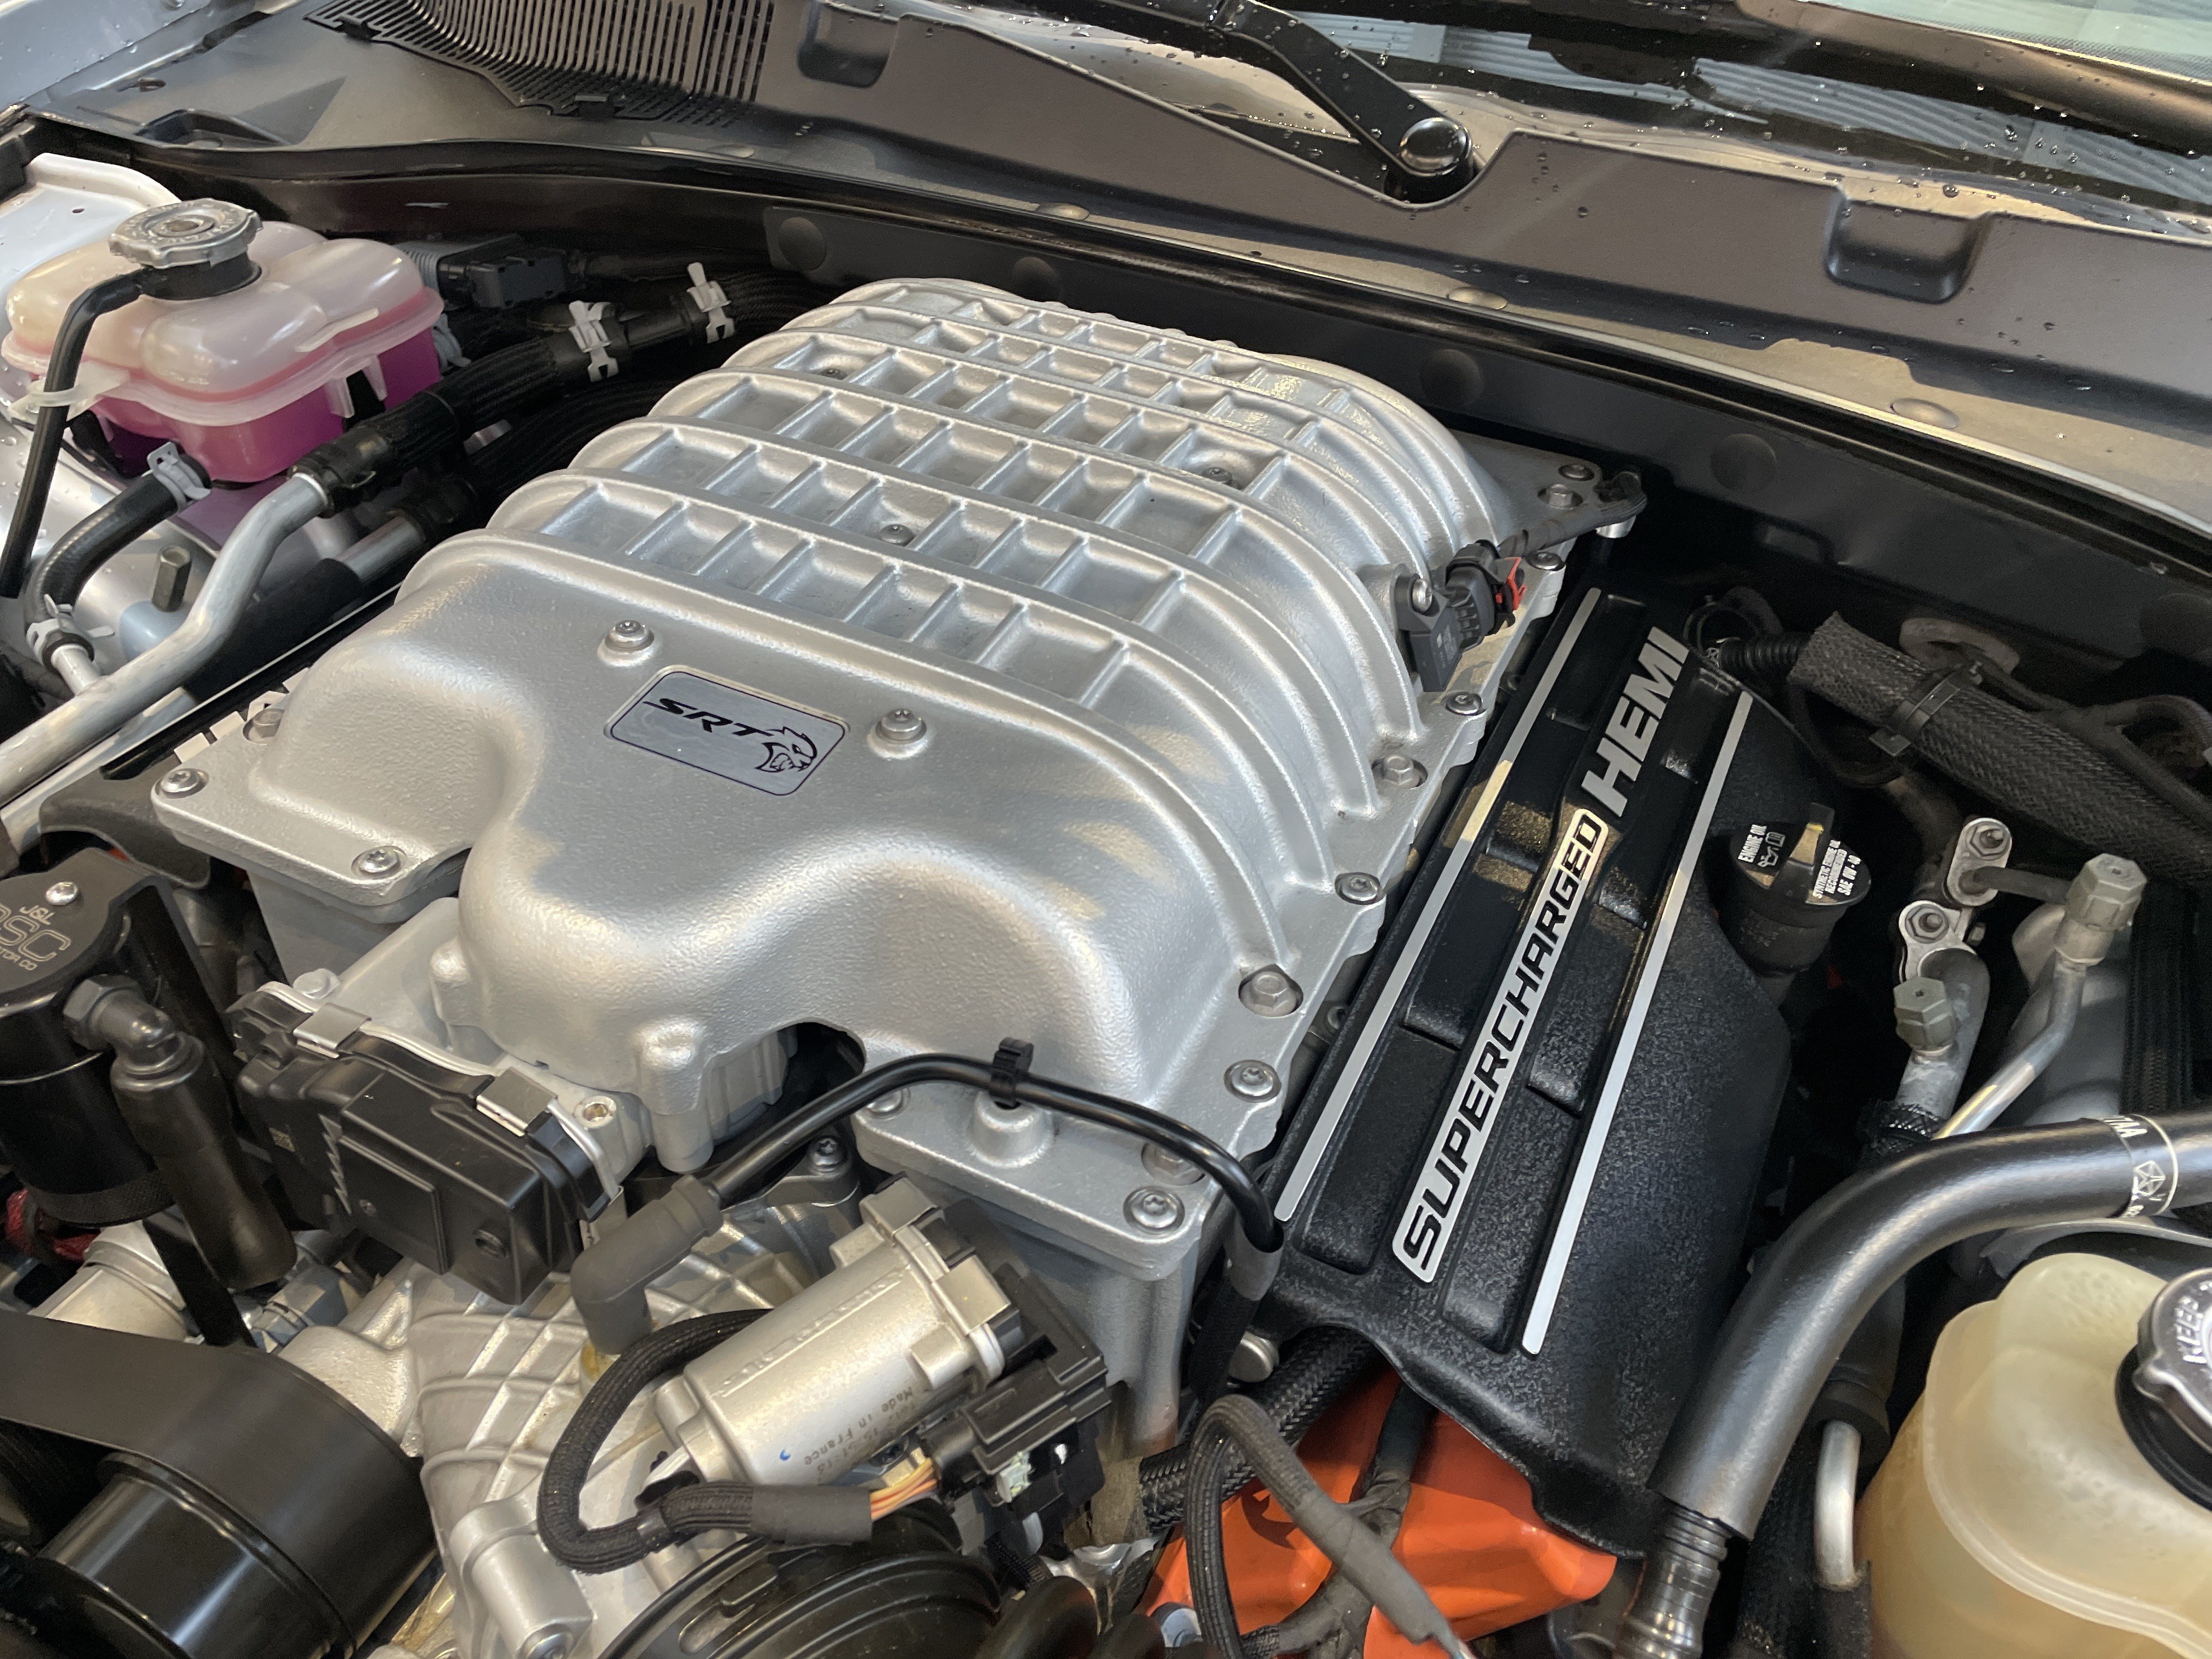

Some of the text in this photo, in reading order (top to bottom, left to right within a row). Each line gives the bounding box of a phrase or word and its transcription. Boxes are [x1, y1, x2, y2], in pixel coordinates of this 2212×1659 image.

[642, 697, 775, 737] SRT
[1581, 626, 1689, 817] HEMI
[1738, 824, 1767, 863] ENGINE OIL
[1837, 879, 1854, 895] SAE
[19, 905, 56, 926] J&L
[1403, 814, 1602, 1271] SUPERCHARGED
[881, 1386, 913, 1413] Made
[804, 1427, 854, 1465] France
